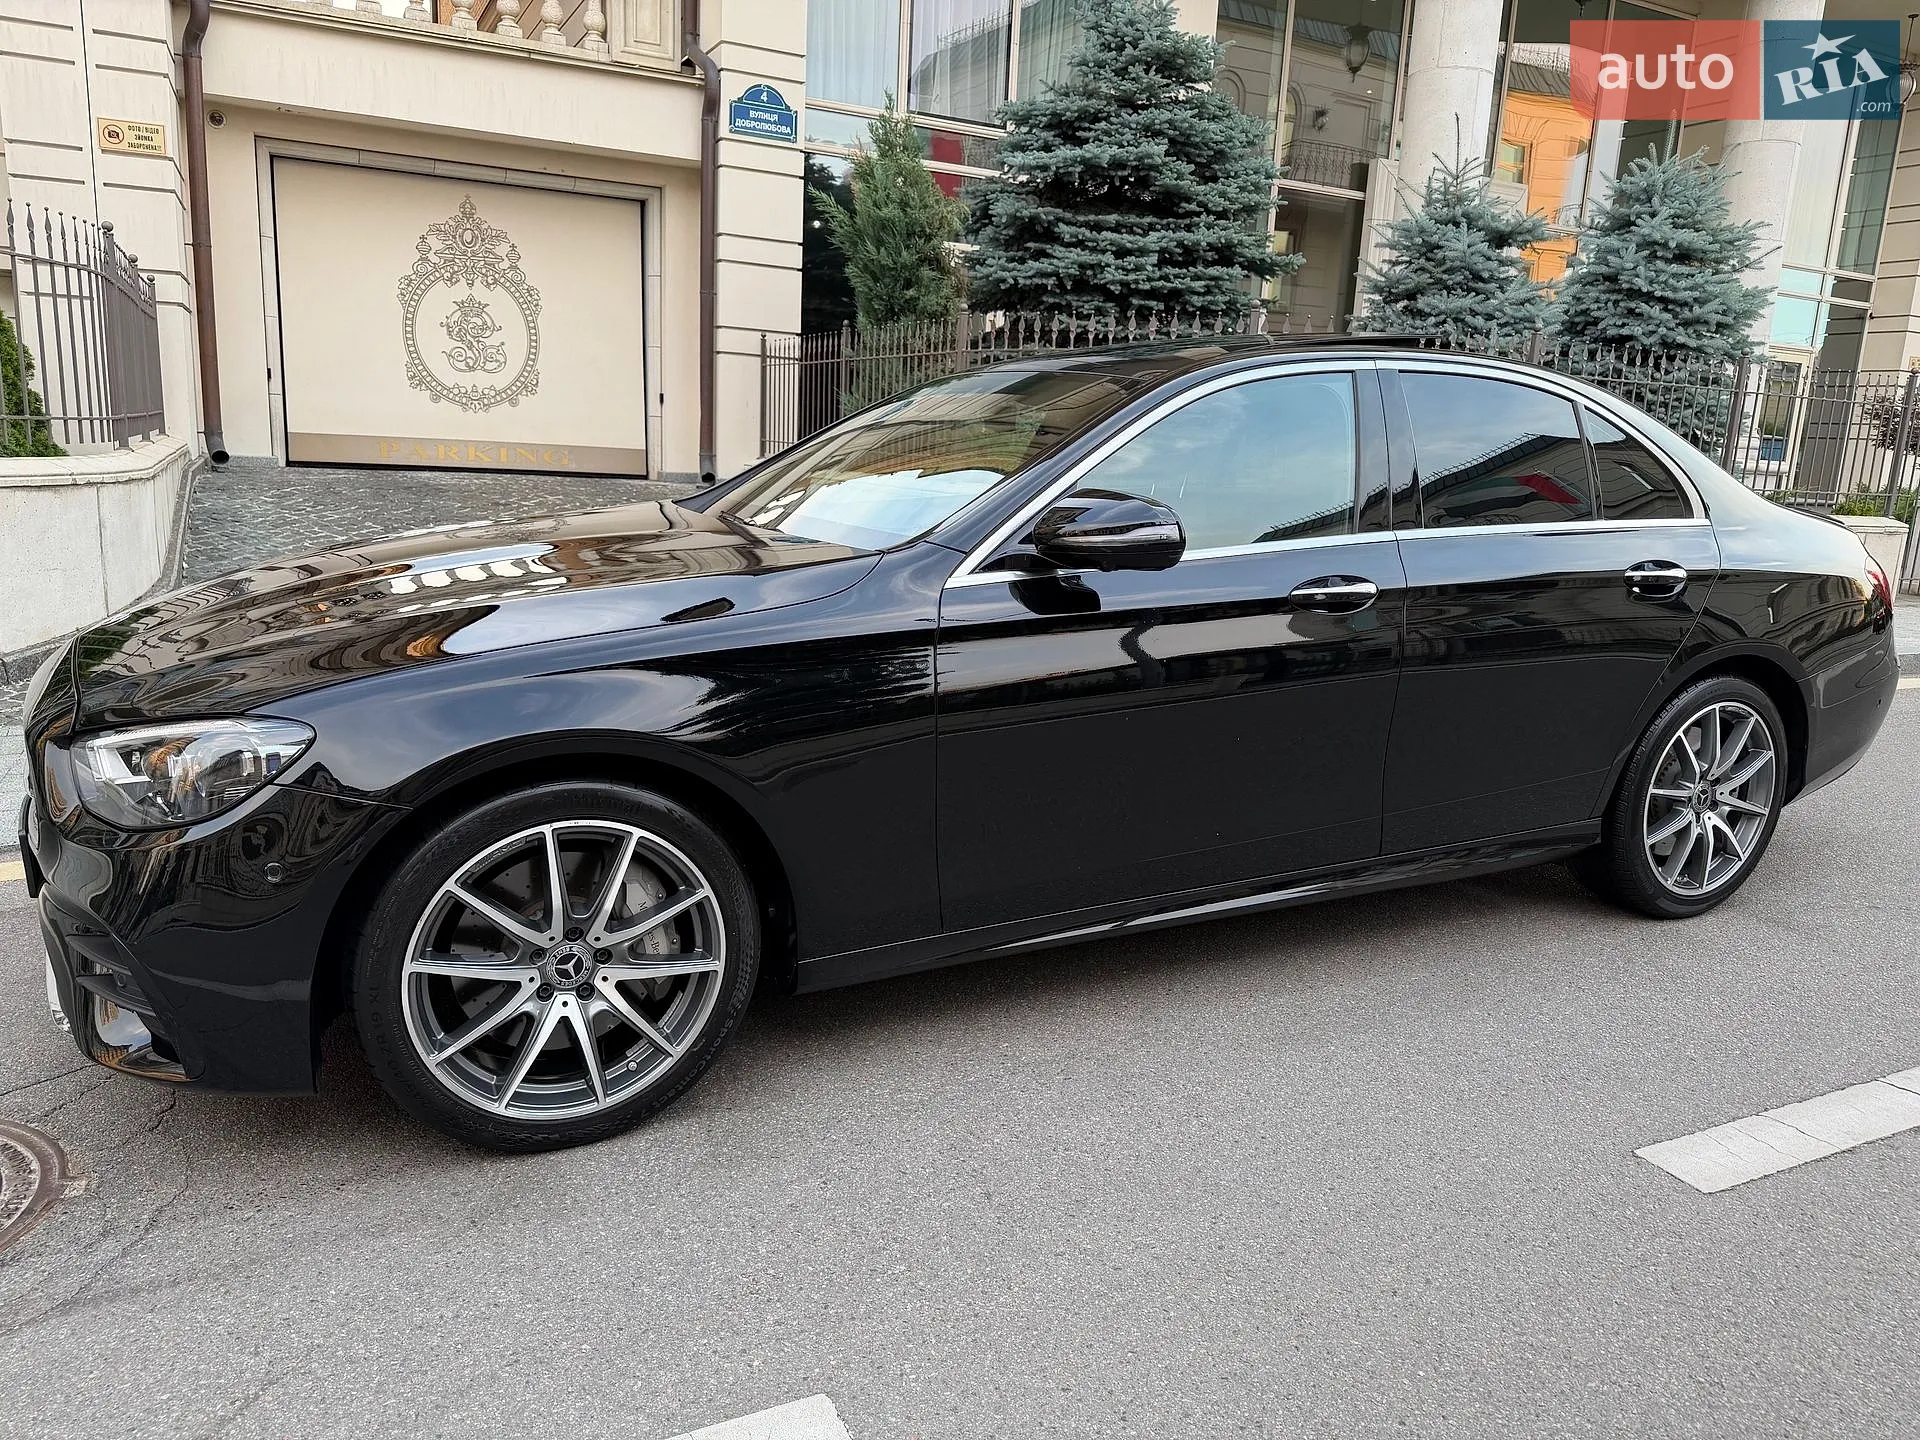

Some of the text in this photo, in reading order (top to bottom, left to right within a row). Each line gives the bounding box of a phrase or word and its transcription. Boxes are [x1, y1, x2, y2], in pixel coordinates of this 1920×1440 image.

[760, 91, 768, 102] 4
[749, 110, 778, 122] ВУЛИЦЯ
[734, 118, 791, 134] ДОБРОЛЮБОВА
[378, 439, 571, 466] PARKING
